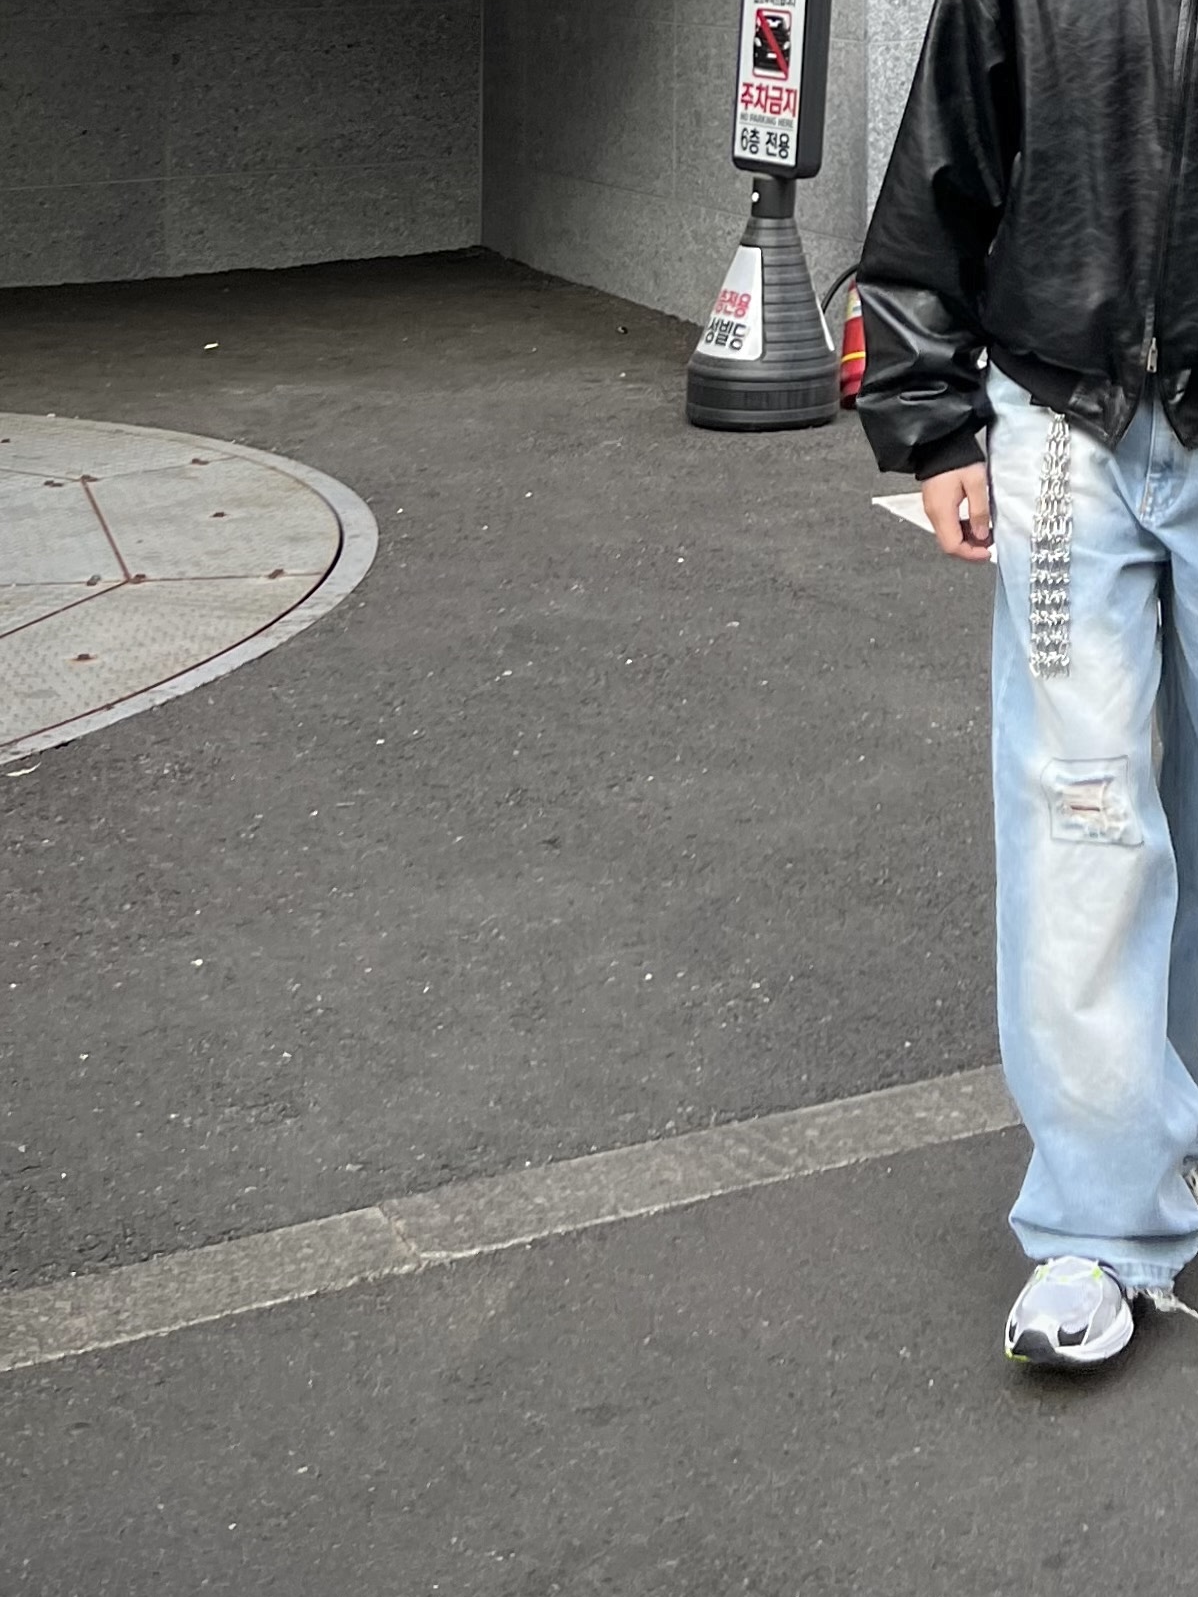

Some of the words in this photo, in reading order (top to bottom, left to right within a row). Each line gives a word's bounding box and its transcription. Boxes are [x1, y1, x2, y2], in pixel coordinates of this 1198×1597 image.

[741, 82, 797, 118] 주차금지
[741, 127, 760, 155] 6층
[766, 131, 789, 159] 전용
